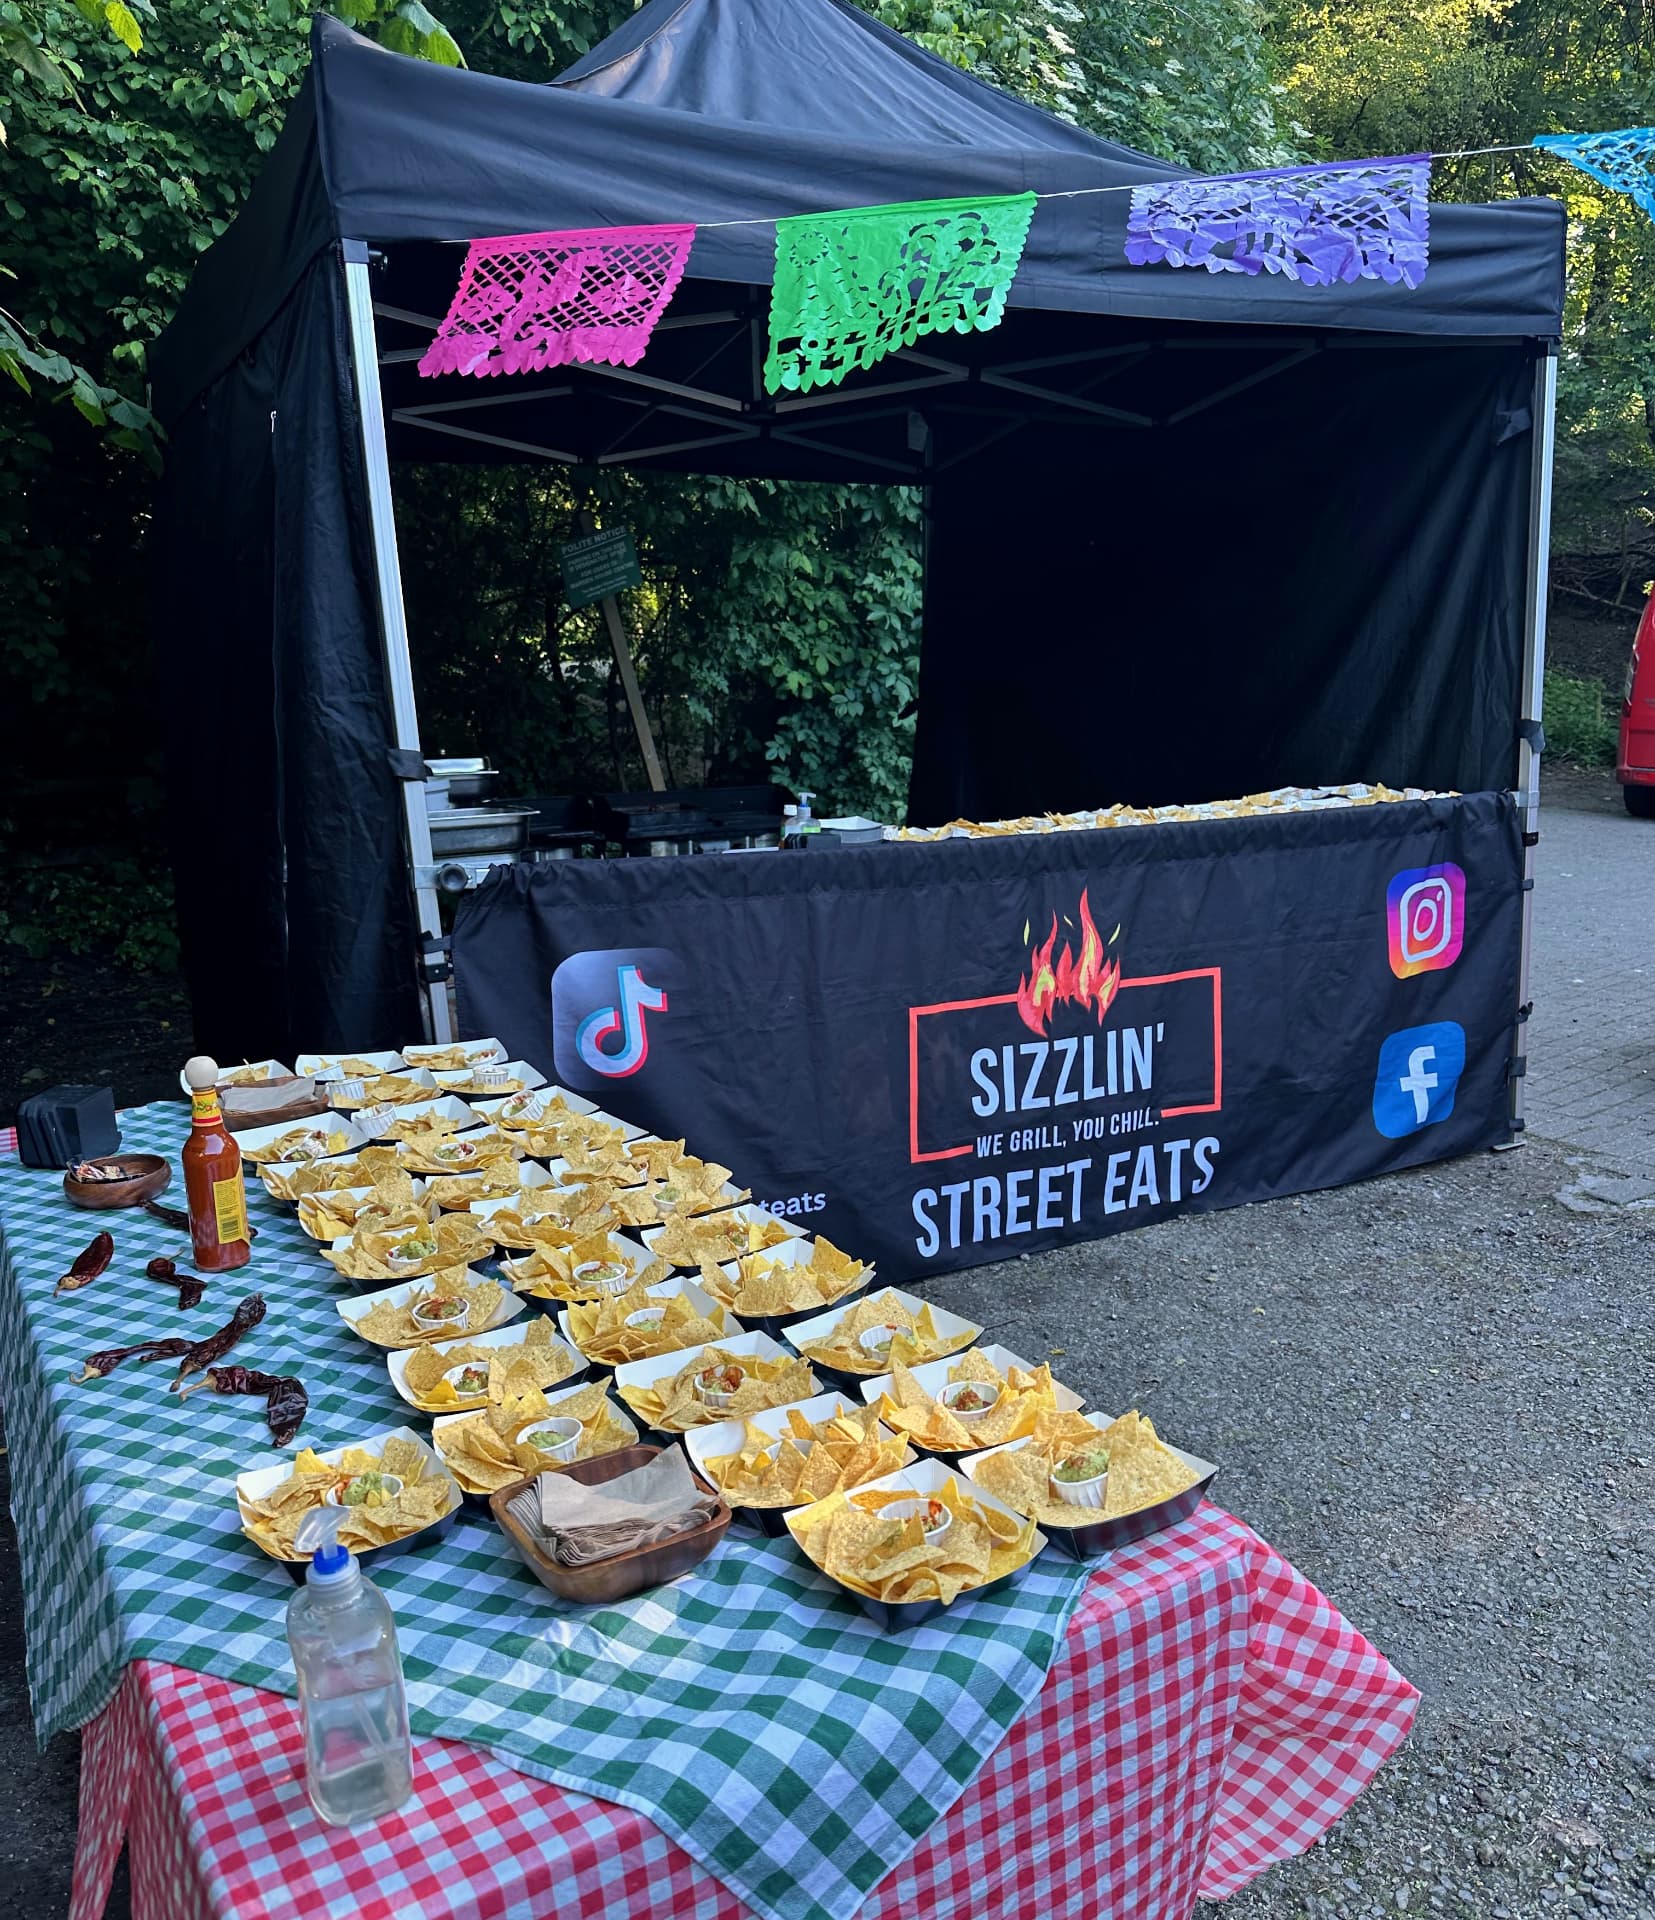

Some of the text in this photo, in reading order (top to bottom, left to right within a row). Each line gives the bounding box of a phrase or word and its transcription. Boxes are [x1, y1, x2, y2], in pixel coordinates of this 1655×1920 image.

[561, 525, 626, 554] POLITE NOTICE
[970, 1022, 1165, 1118] SIZZLIN'
[976, 1106, 1160, 1158] WE GRILL, YOU CHILL.
[911, 1136, 1221, 1258] STREET EATS
